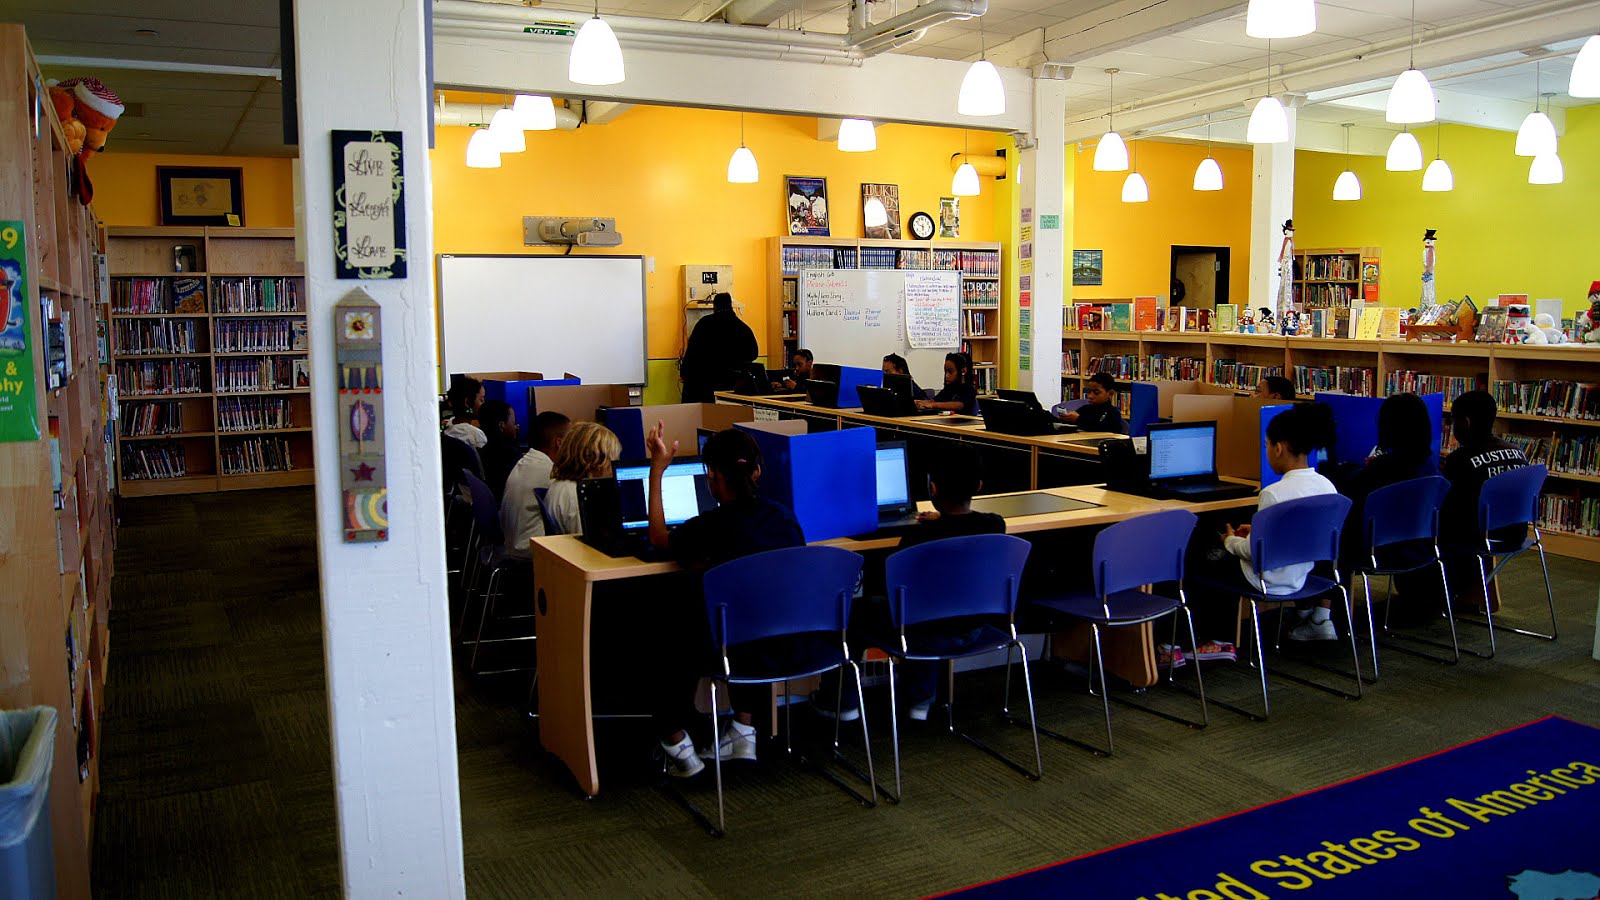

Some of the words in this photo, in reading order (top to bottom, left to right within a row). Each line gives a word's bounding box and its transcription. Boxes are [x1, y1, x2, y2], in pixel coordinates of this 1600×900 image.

[529, 28, 559, 36] VENT
[0, 227, 18, 249] 9
[976, 282, 998, 291] BOOK
[6, 361, 17, 376] &
[0, 377, 24, 395] hy
[1250, 829, 1421, 890] States
[1408, 807, 1470, 838] of
[1445, 762, 1600, 823] America
